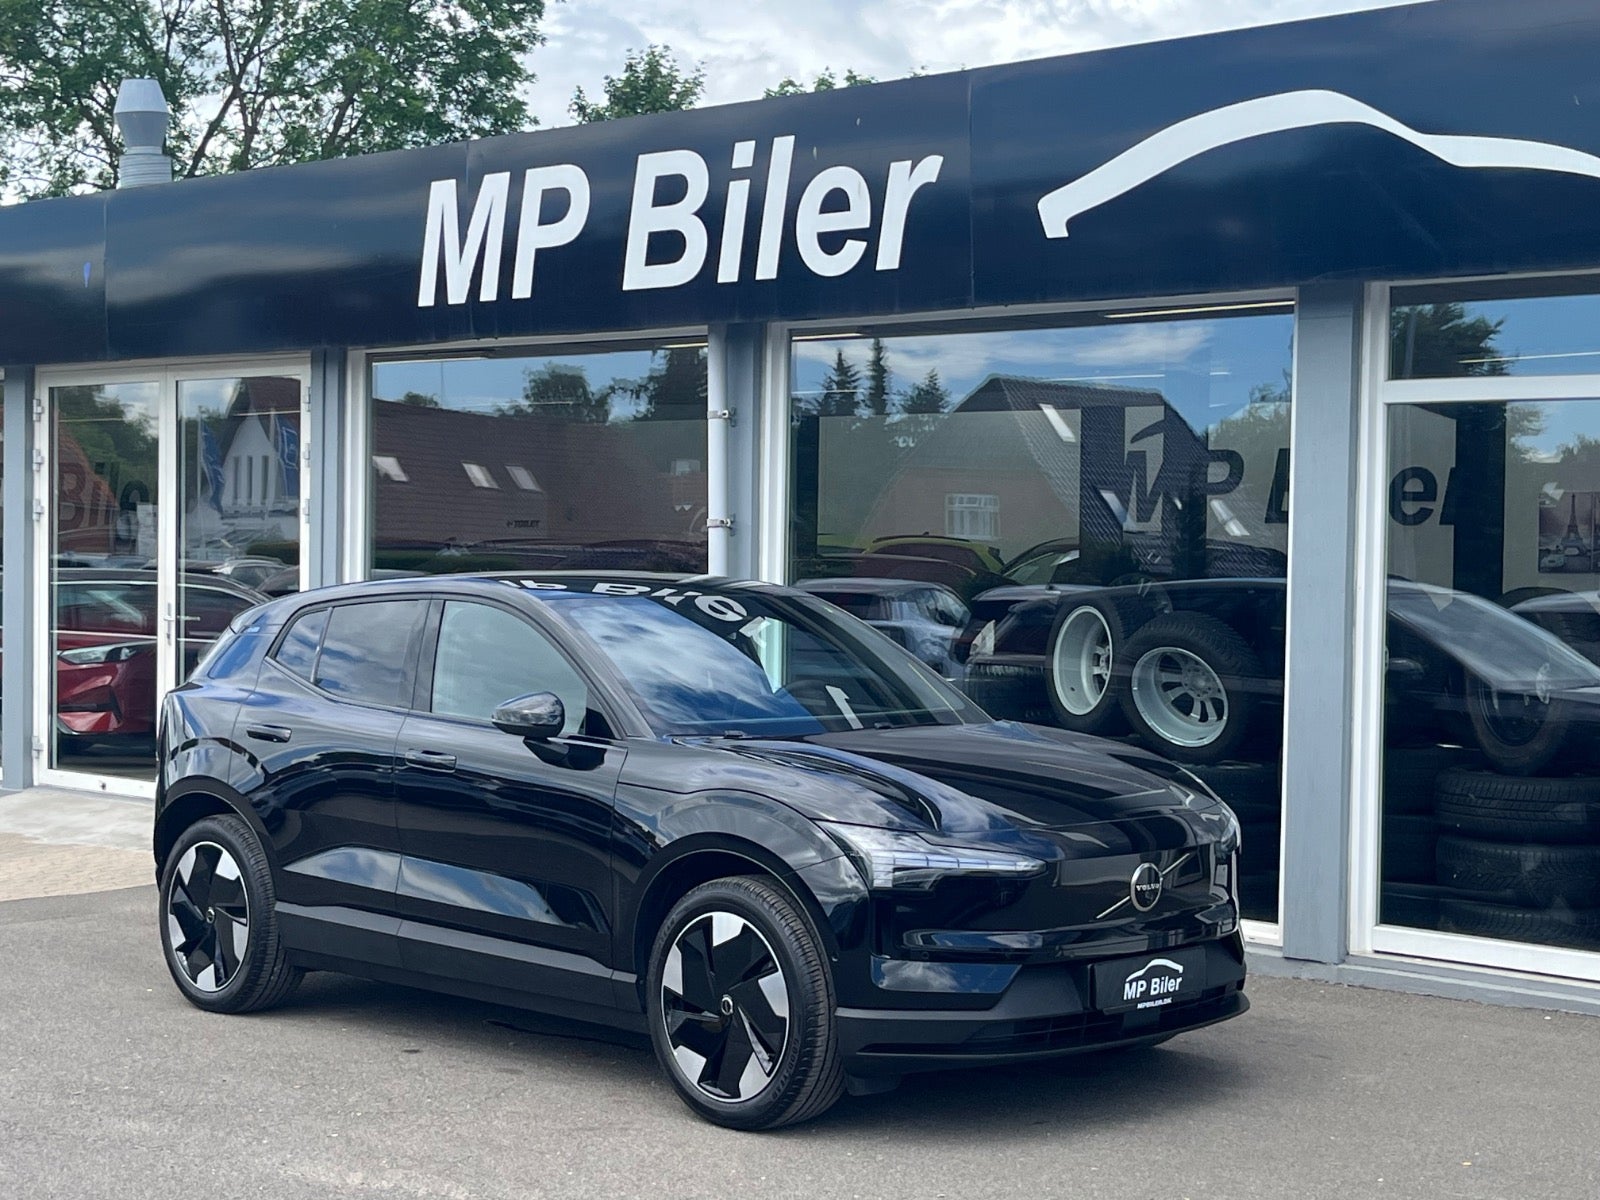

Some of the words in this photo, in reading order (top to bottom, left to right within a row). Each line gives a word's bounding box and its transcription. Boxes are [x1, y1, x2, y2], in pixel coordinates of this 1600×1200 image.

[418, 163, 591, 307] MP
[622, 134, 944, 291] Biler
[1123, 979, 1147, 1000] MP
[1150, 975, 1182, 995] Biler
